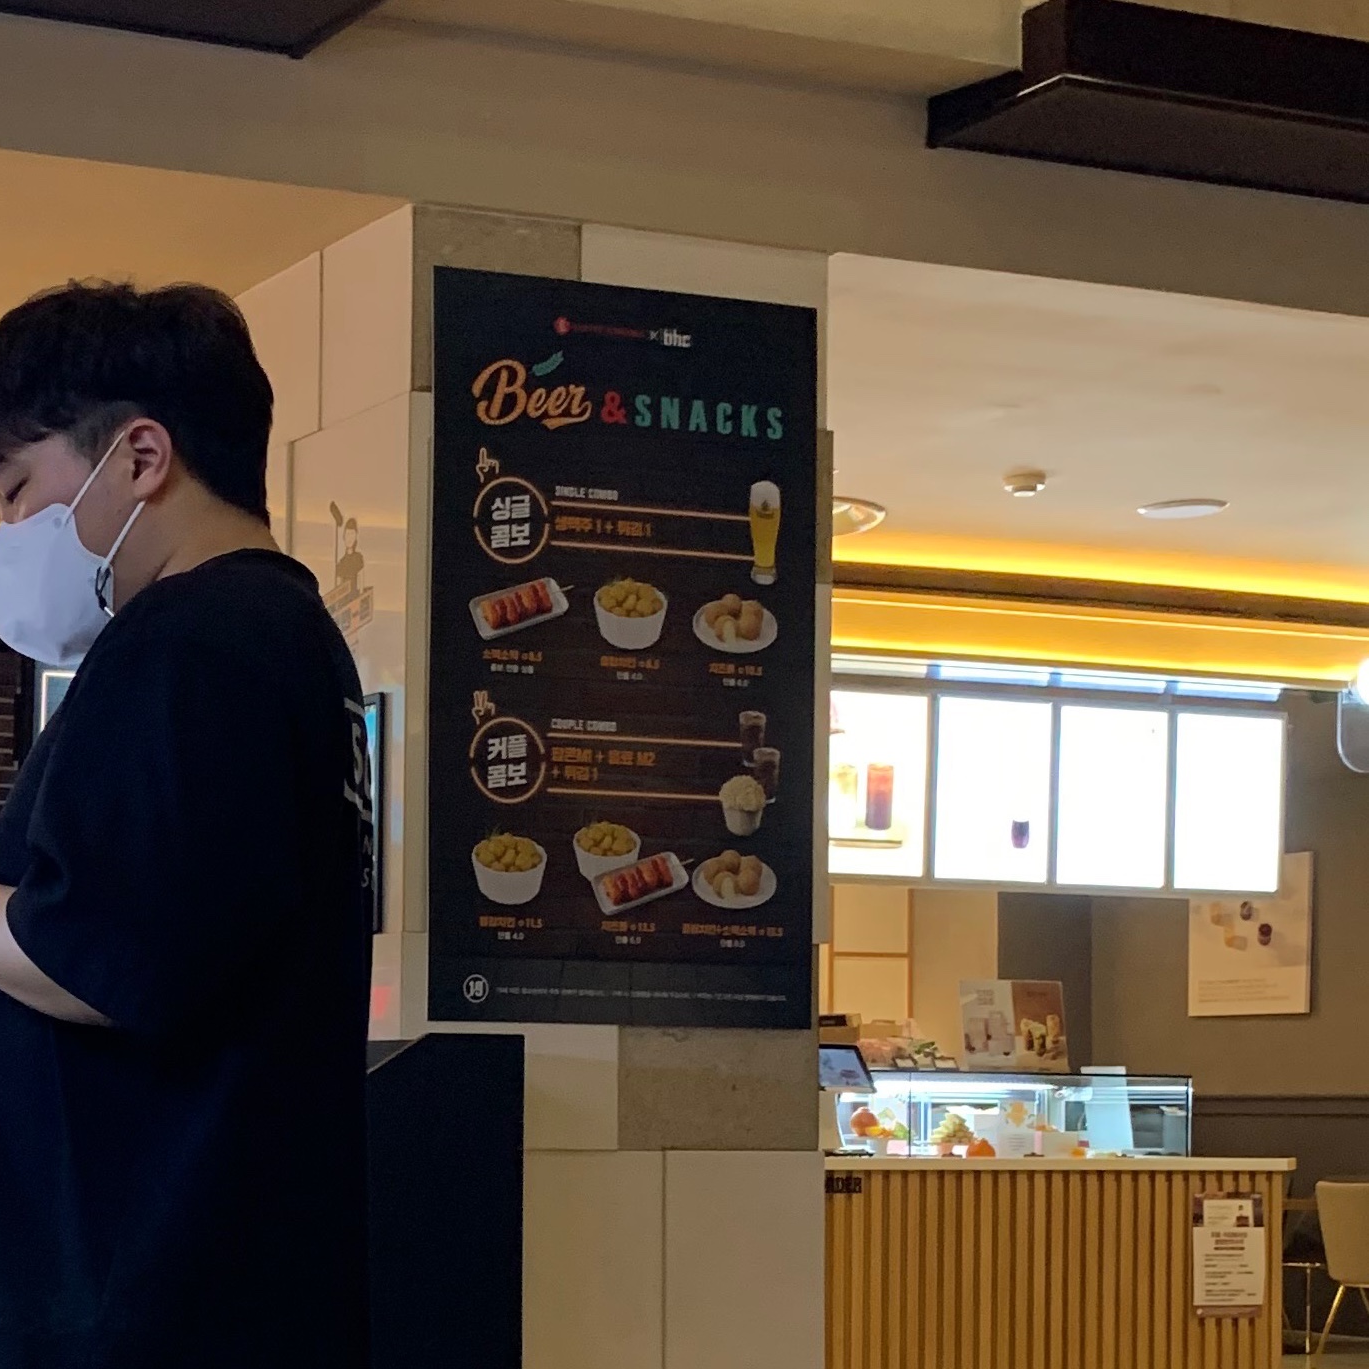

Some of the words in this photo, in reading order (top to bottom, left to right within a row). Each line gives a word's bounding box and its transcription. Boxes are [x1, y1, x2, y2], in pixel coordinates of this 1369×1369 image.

[472, 357, 592, 430] Beer
[600, 391, 628, 424] &
[634, 393, 784, 440] SNACKS
[491, 494, 531, 520] 싱글
[490, 522, 531, 549] 콤보
[486, 733, 528, 761] 커플
[486, 762, 528, 789] 콤보
